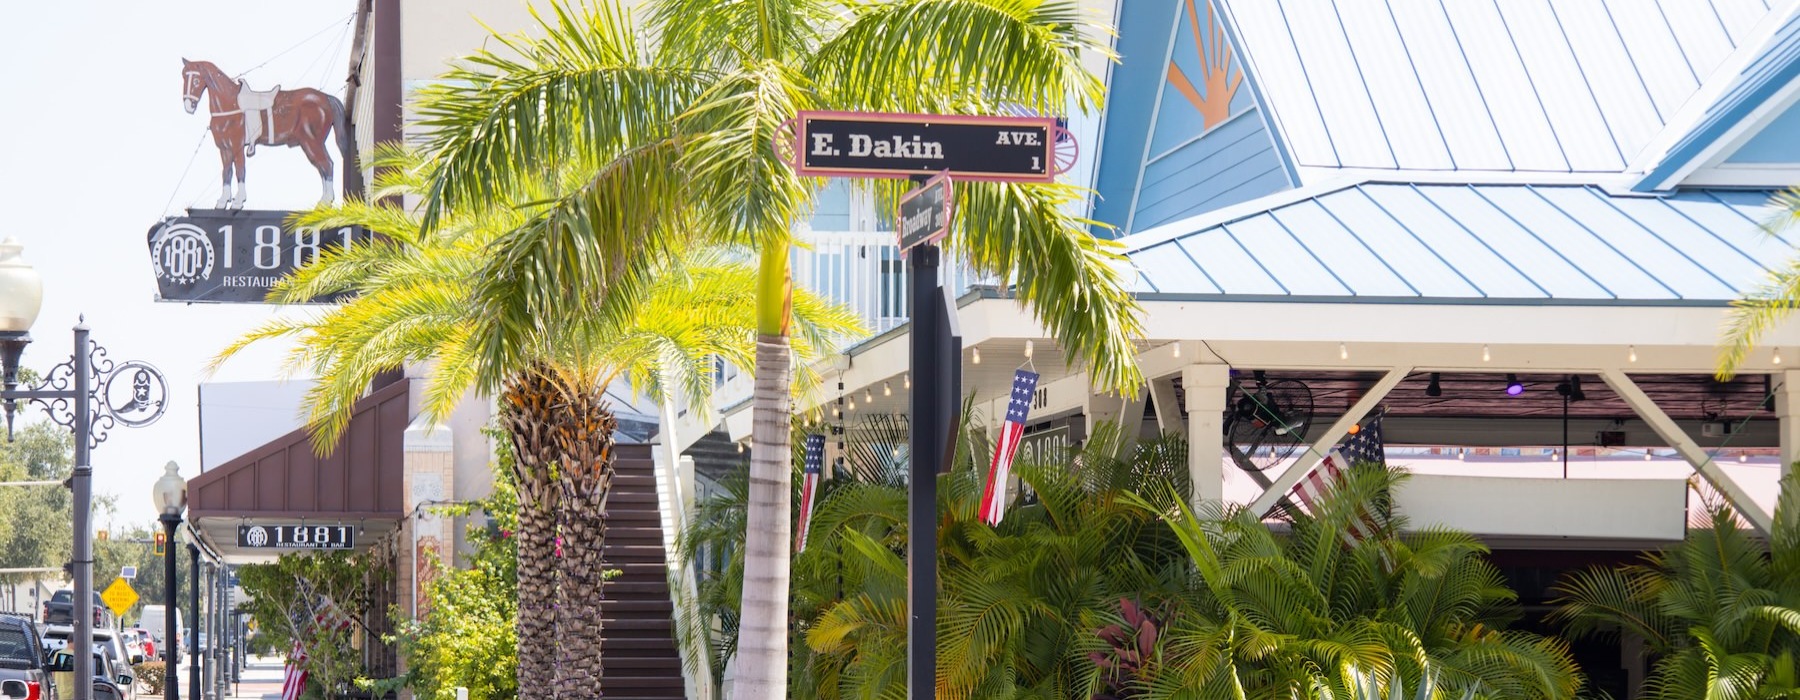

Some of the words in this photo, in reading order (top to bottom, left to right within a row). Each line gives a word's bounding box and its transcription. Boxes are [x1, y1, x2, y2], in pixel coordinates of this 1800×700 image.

[811, 132, 840, 156] E.
[848, 133, 944, 160] Dakin
[995, 130, 1042, 147] AVE.
[1031, 156, 1041, 171] 1
[902, 206, 933, 239] Broadway
[164, 235, 203, 278] 1881
[218, 224, 352, 270] 1881
[222, 275, 296, 288] RESTAURA
[1036, 433, 1067, 485] 1881
[275, 526, 347, 544] 1881
